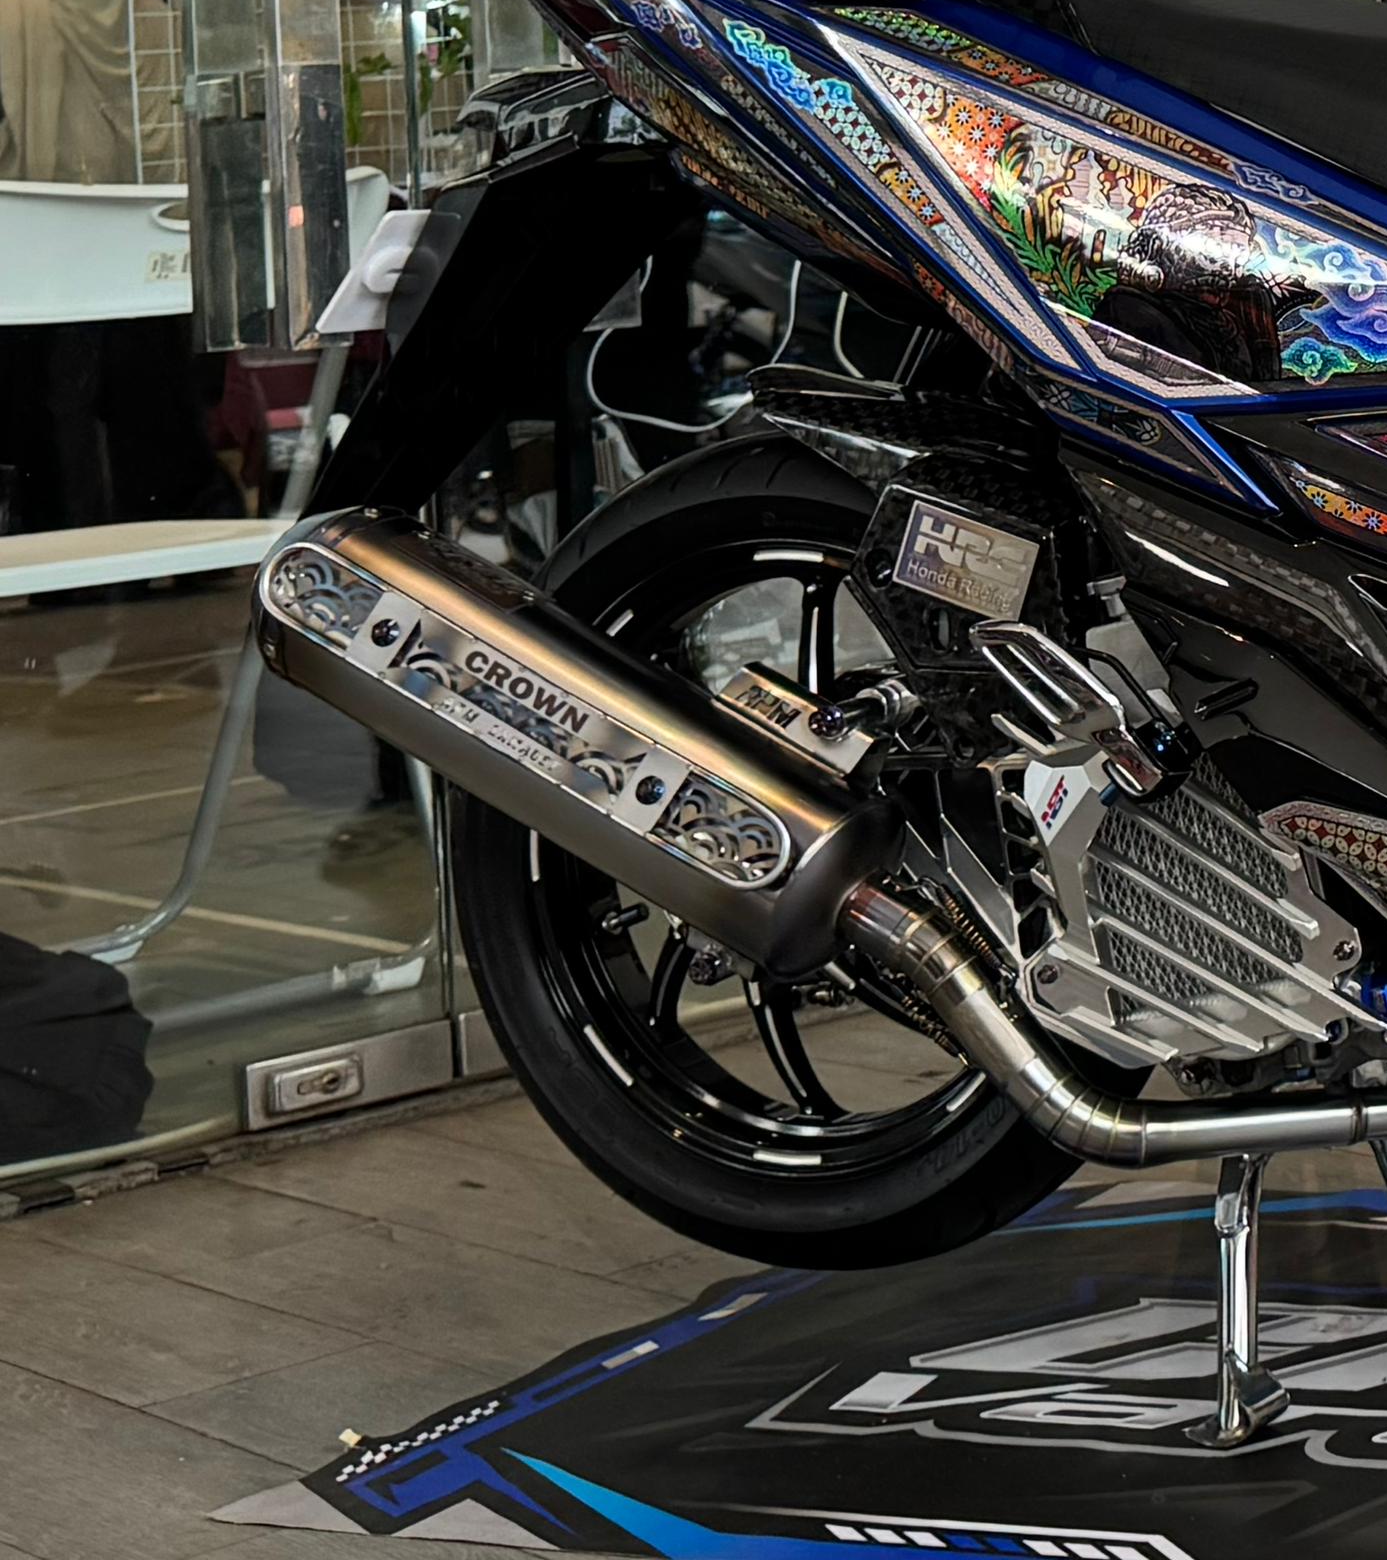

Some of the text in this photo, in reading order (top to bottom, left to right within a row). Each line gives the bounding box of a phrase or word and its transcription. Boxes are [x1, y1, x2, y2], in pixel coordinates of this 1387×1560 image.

[907, 559, 1012, 613] Honda Racing
[465, 650, 590, 734] CROWN
